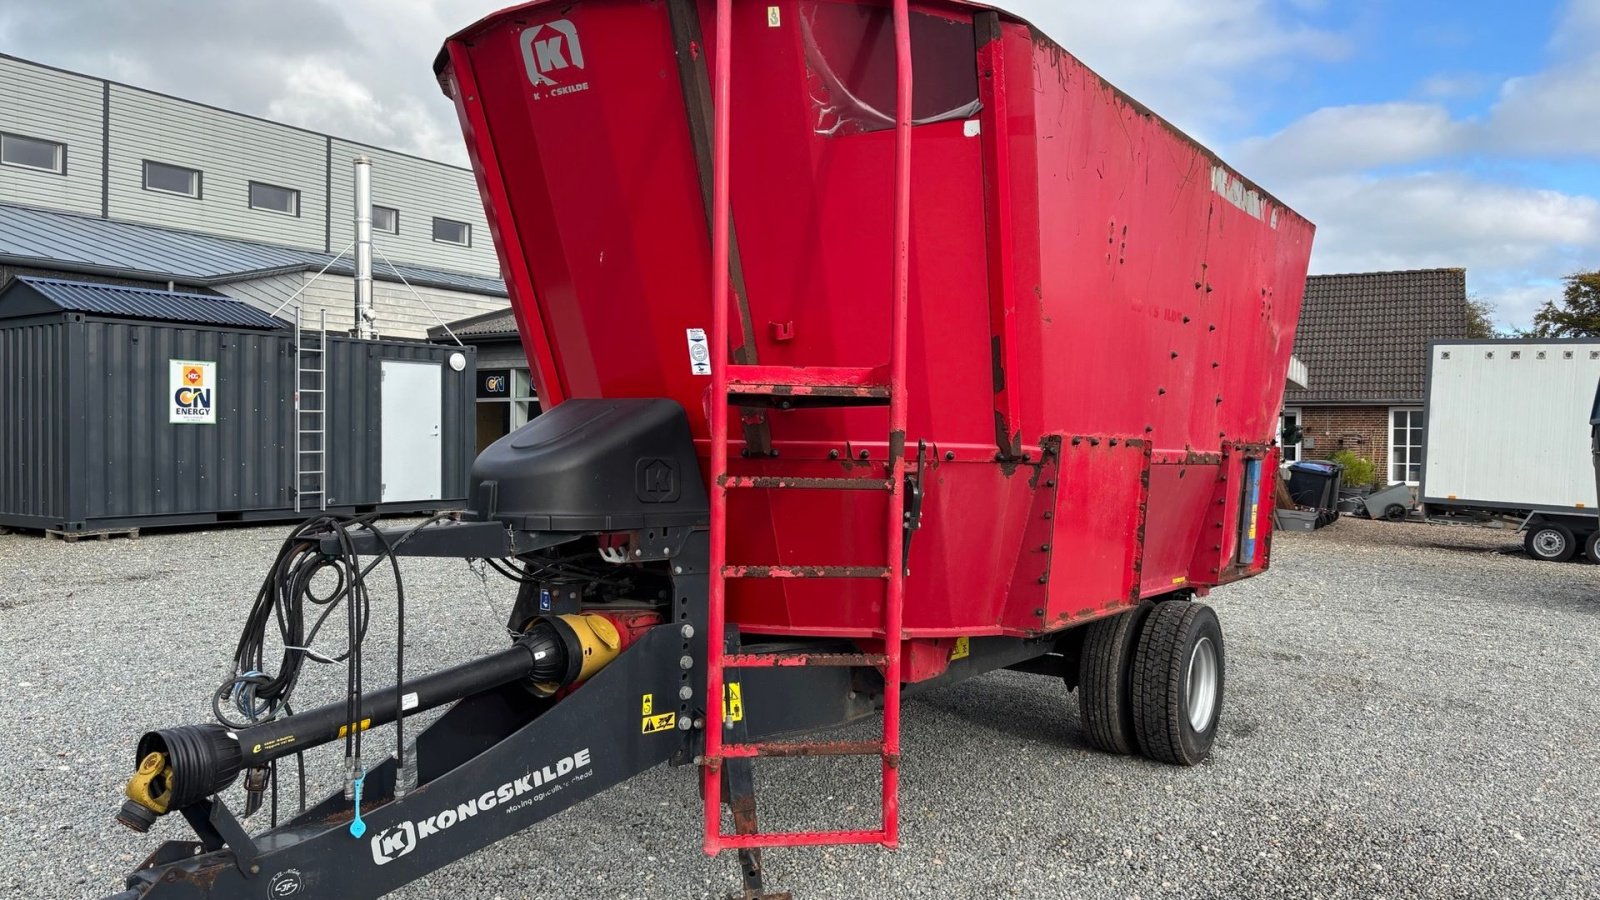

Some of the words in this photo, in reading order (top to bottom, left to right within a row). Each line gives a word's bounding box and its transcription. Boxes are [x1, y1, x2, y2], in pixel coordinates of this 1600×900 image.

[534, 35, 569, 73] K
[175, 387, 211, 408] CN
[176, 408, 211, 416] ENERGY
[418, 748, 592, 839] KONGSKILDE
[506, 798, 533, 815] Moving
